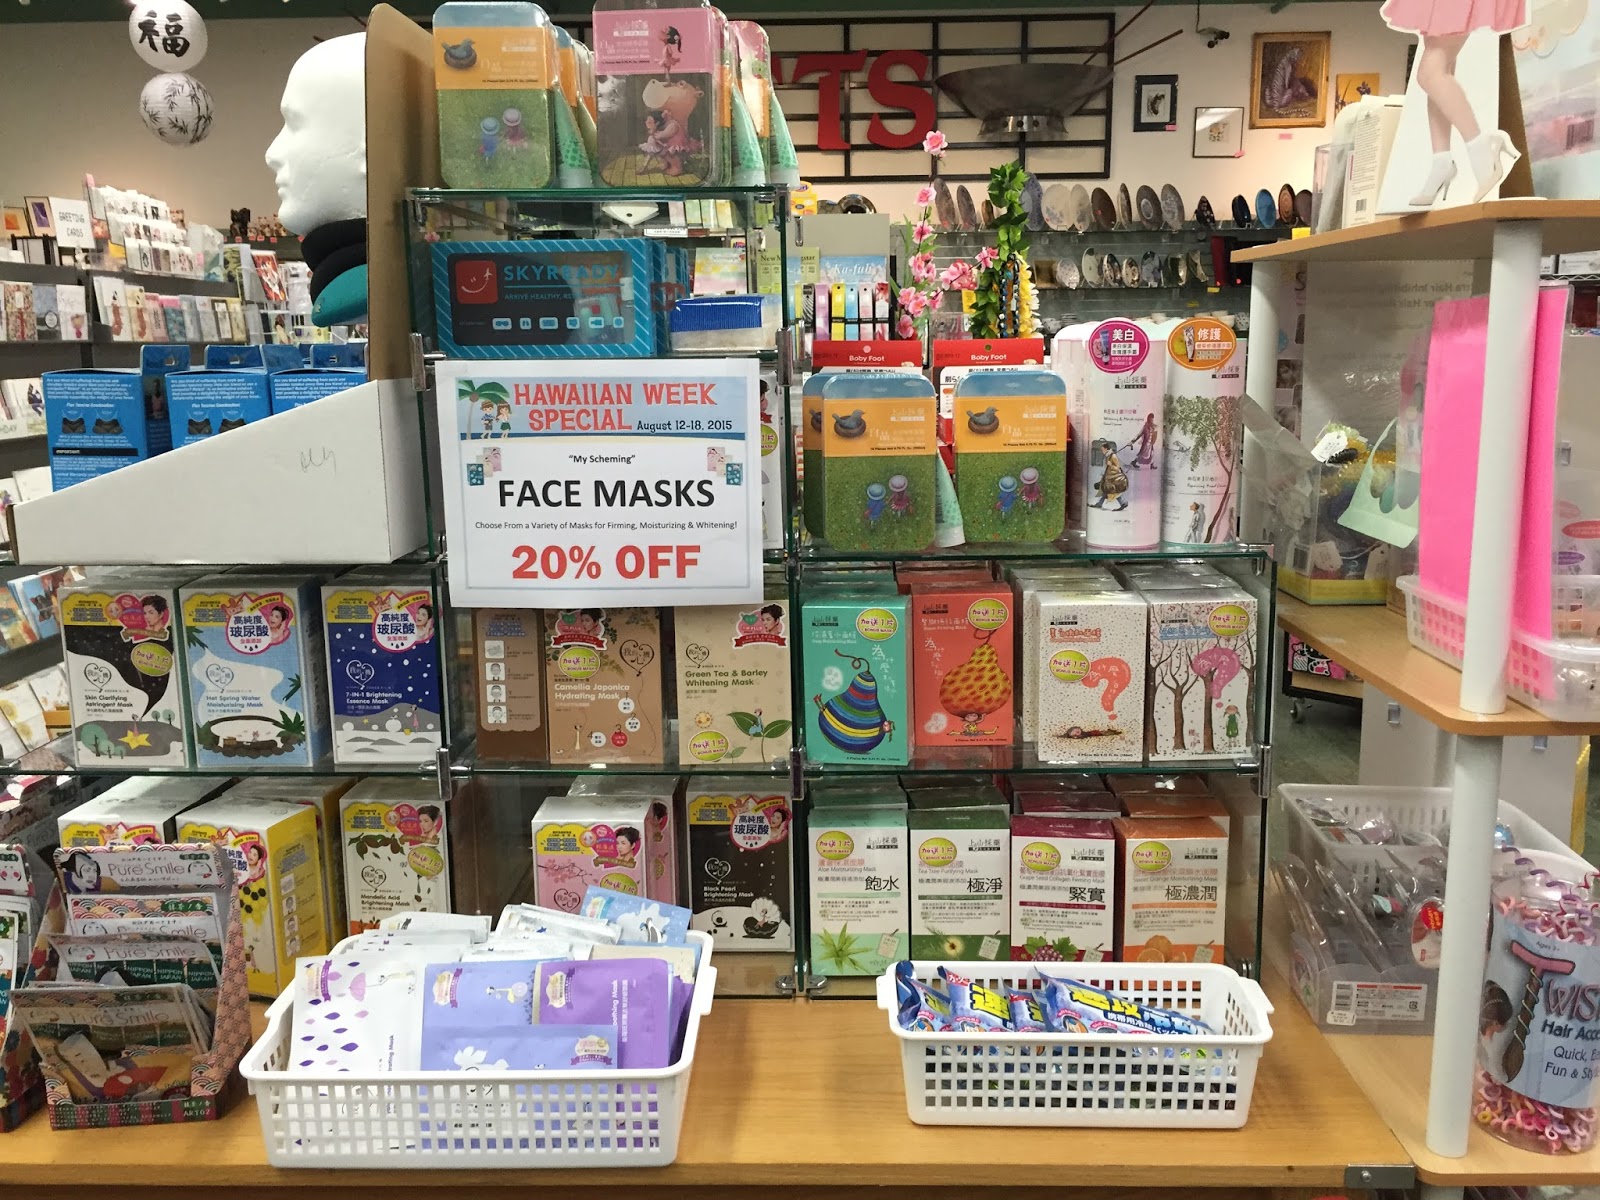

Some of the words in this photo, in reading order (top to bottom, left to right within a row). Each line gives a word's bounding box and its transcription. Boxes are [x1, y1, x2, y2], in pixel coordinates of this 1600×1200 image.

[138, 10, 190, 57] 福
[771, 49, 936, 149] TS
[761, 254, 776, 262] New
[503, 264, 620, 281] SKYREADY
[834, 263, 872, 274] Ka-fuh
[1112, 328, 1135, 341] 美白
[1197, 328, 1221, 341] 修護
[849, 354, 867, 363] Baby
[971, 354, 989, 362] Baby
[513, 383, 632, 406] HAWAIIAN
[643, 383, 717, 405] WEEK
[528, 409, 632, 431] SPECIAL
[636, 420, 672, 433] August
[675, 419, 705, 431] 12-18,
[707, 420, 732, 430] 2015
[499, 480, 581, 507] FACE
[594, 480, 715, 507] MASKS
[475, 521, 502, 530] Choose
[504, 521, 524, 530] From
[531, 521, 558, 531] Variety
[559, 521, 568, 530] of
[569, 521, 593, 530] Masks
[594, 521, 606, 530] for
[607, 521, 637, 532] Firming,
[640, 521, 686, 532] Moisturizing
[688, 521, 694, 530] &
[696, 521, 737, 530] Whitening!
[512, 545, 602, 580] 20%
[616, 545, 701, 580] OFF
[233, 615, 263, 625] 高純度
[381, 613, 410, 622] 高純度
[229, 625, 269, 638] 玻尿酸
[377, 623, 415, 635] 玻尿酸
[685, 670, 711, 678] Green
[741, 669, 768, 678] Barley
[554, 683, 591, 691] Camellia
[592, 683, 630, 692] Japonica
[685, 679, 729, 687] Whitening
[555, 692, 595, 701] Hydrating
[598, 692, 620, 700] Mask
[739, 815, 765, 823] 高純度
[734, 824, 769, 835] 玻尿酸
[108, 863, 144, 877] Pure
[145, 862, 185, 875] Smile
[865, 875, 900, 891] 飽水
[967, 877, 1003, 893] 極淨
[1170, 875, 1202, 883] Moisturizing
[1069, 887, 1106, 903] 緊實
[1165, 884, 1217, 901] 極濃潤
[159, 925, 207, 937] Smile
[1536, 941, 1551, 950] Ages
[104, 947, 146, 960] Pure
[149, 945, 197, 957] Smile
[116, 1010, 169, 1025] Smile
[1541, 1019, 1574, 1038] Hair
[1553, 1045, 1588, 1062] Quick,
[1544, 1062, 1567, 1077] Fun
[1570, 1068, 1579, 1079] &
